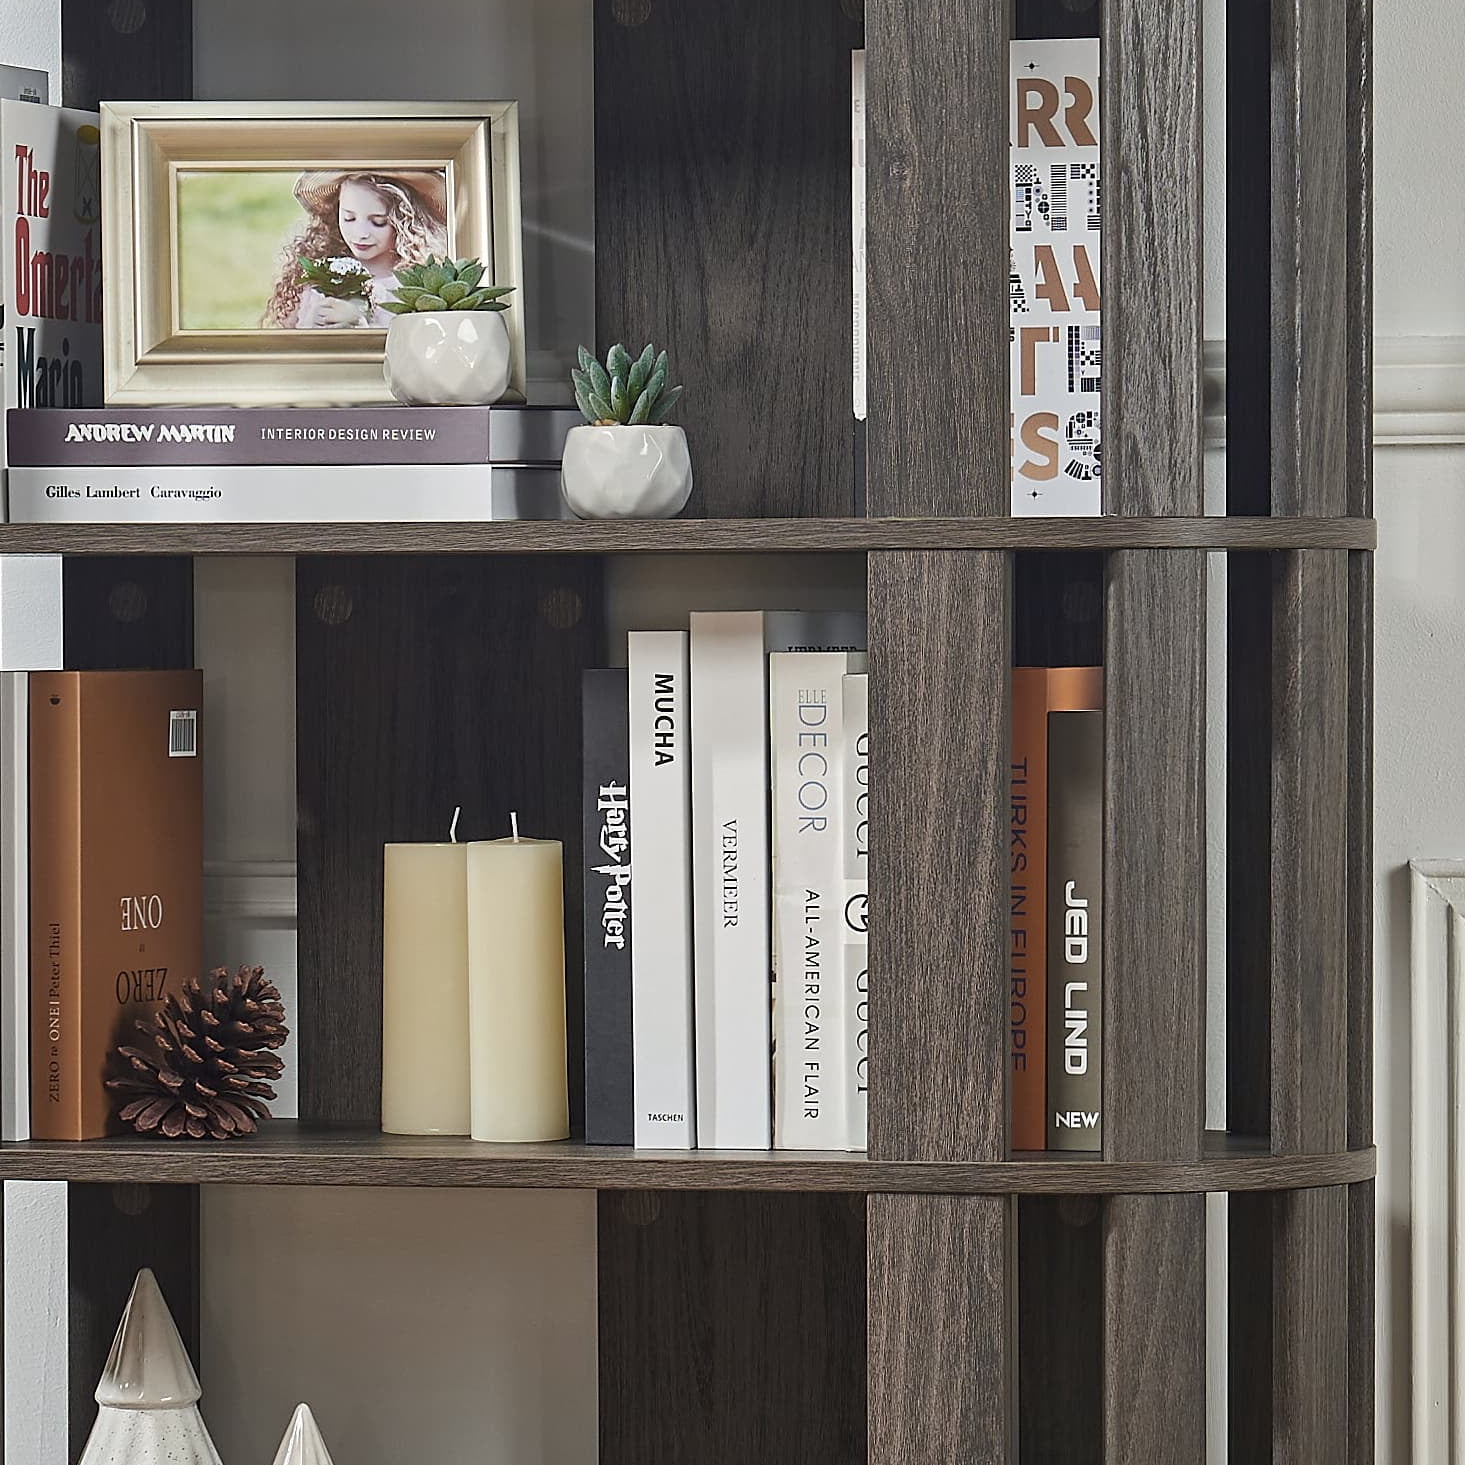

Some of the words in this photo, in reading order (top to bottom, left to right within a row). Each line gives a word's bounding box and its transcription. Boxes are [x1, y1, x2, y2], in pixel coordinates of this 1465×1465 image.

[15, 144, 49, 218] The
[64, 422, 155, 444] ANDREW
[156, 422, 236, 444] MARTIN
[260, 427, 326, 442] INTERIOR
[328, 427, 379, 442] DESIGN
[382, 428, 437, 442] REVIEW
[45, 485, 81, 499] Gilles
[85, 485, 141, 499] Lambert
[150, 485, 222, 502] Caravaggio
[798, 689, 827, 704] ELLE
[654, 672, 675, 767] MUCHA
[798, 704, 827, 834] DECOR
[597, 780, 629, 864] Harry
[722, 819, 737, 928] VERMEER
[120, 894, 163, 931] ONE
[589, 862, 632, 950] Potter
[1011, 886, 1027, 916] IN
[48, 922, 61, 960] Thiel
[1064, 879, 1088, 966] JED
[49, 961, 61, 999] Peter
[115, 967, 168, 1005] ZERO
[804, 889, 820, 1050] ALL-AMERICAN
[49, 1006, 61, 1042] ONE
[1064, 981, 1088, 1076] LIND
[49, 1060, 60, 1103] ZERO
[804, 1062, 820, 1119] FLAIR
[647, 1113, 684, 1122] TASCHEN
[1055, 1111, 1099, 1129] NEW
